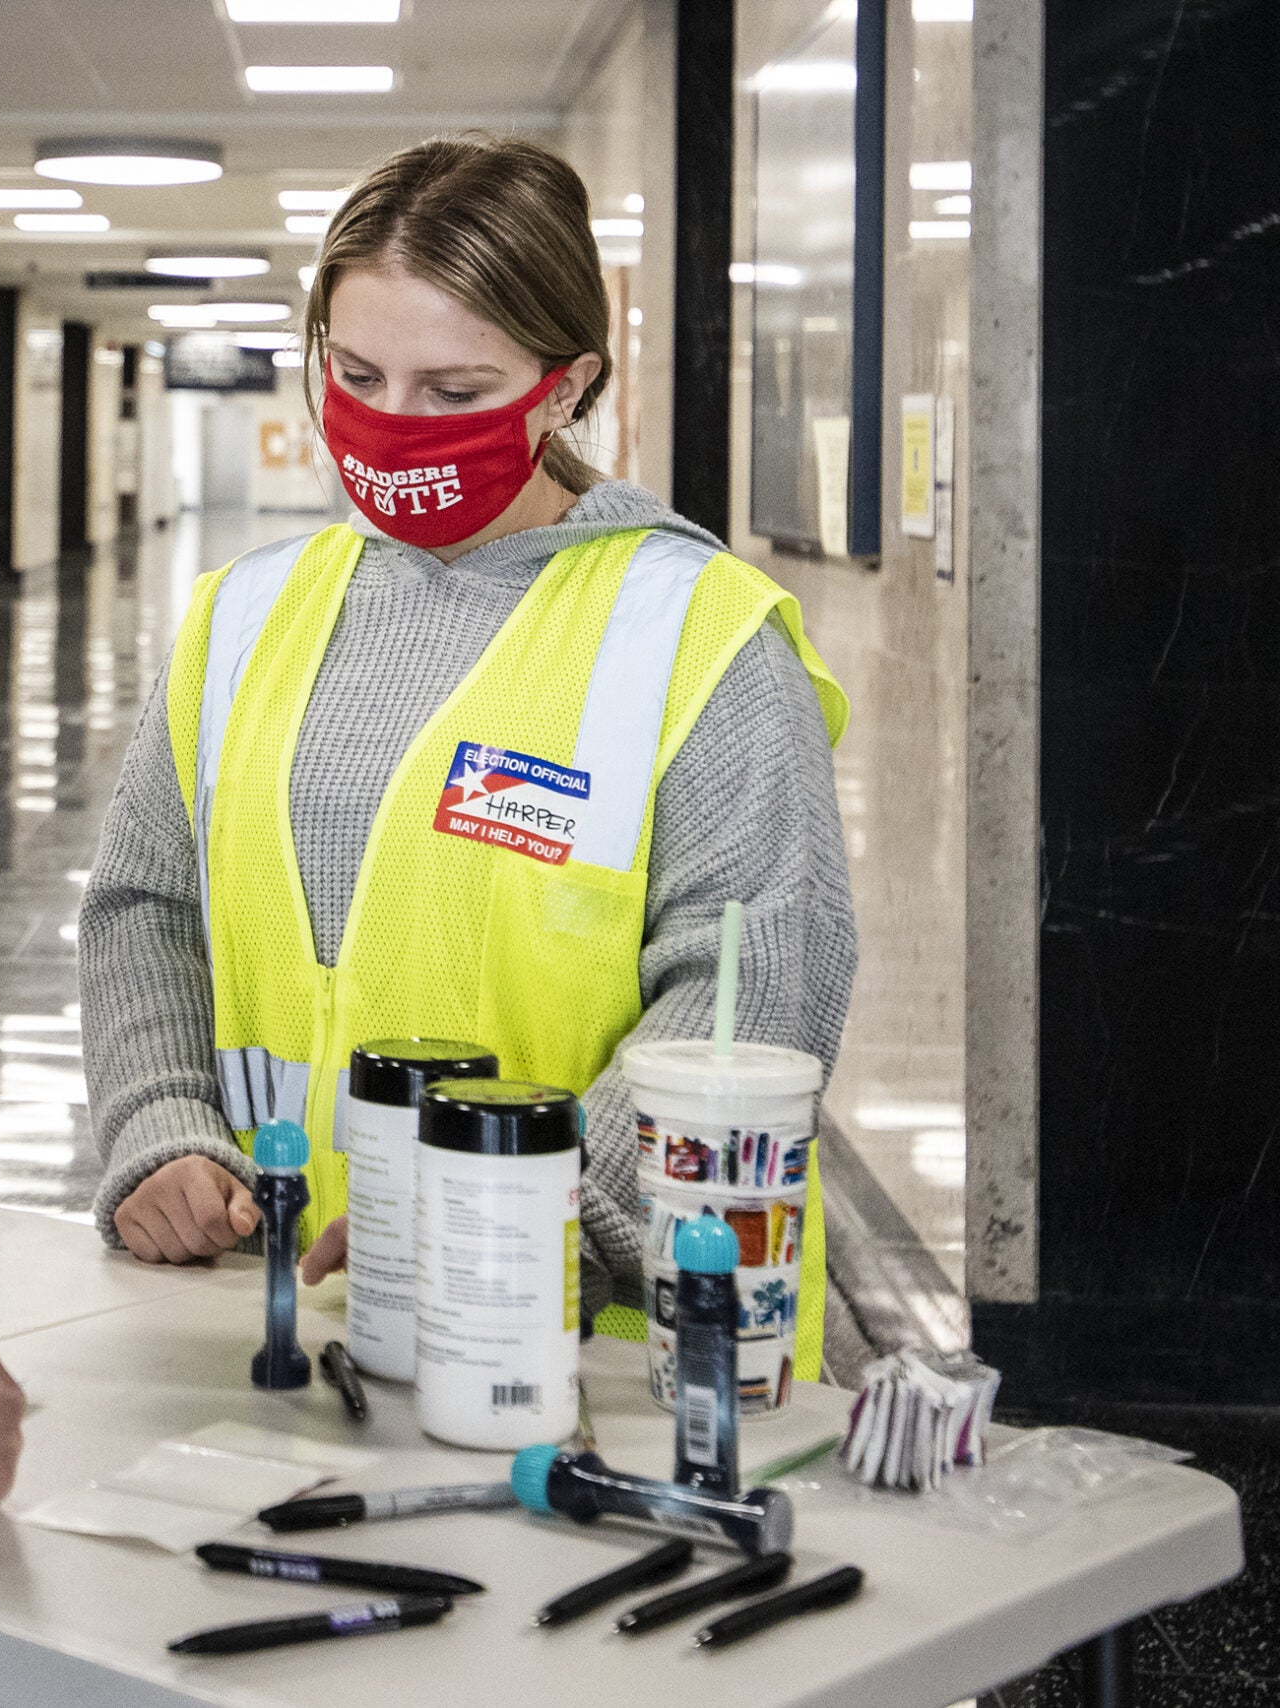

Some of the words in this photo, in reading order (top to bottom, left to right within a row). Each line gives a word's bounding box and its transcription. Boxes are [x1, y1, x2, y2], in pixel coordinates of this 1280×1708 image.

[342, 453, 458, 488] #BADGERS
[344, 471, 464, 517] VOTE
[463, 749, 529, 774] ELECTION
[531, 765, 588, 792] OFFICIAL
[449, 817, 479, 834] MAY
[481, 825, 486, 838] I
[488, 827, 526, 847] HELP
[528, 838, 563, 860] YOU?
[485, 794, 576, 840] HARPER
